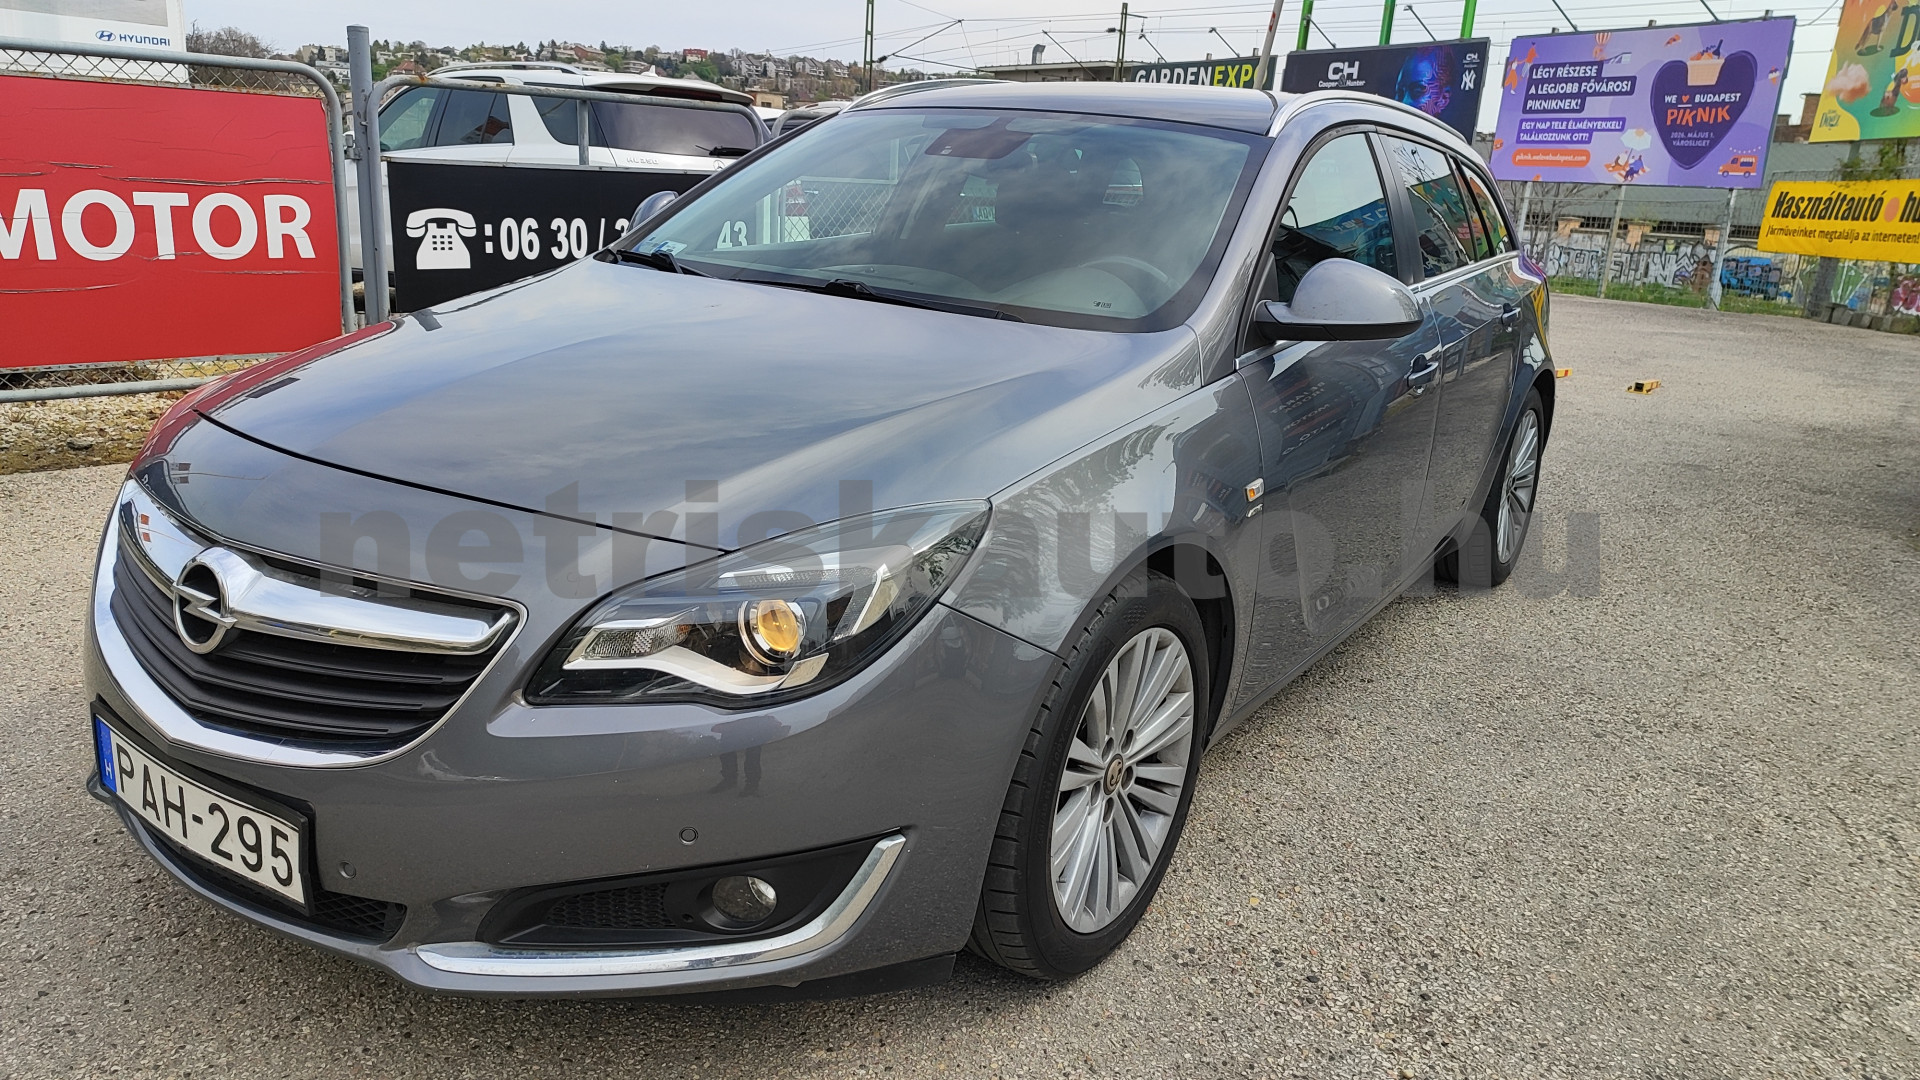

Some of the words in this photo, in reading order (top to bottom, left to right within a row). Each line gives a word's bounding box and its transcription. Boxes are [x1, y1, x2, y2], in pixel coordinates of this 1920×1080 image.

[119, 33, 171, 47] HYUNDAI
[1327, 60, 1360, 80] CH
[1532, 66, 1555, 79] LÉGY
[1557, 65, 1598, 77] RÉSZESE
[1529, 84, 1536, 94] A
[1538, 82, 1579, 94] LEGJOBB
[1580, 79, 1632, 93] FŐVÁROSI
[1526, 98, 1581, 110] PIKNIKNEK!
[1664, 95, 1678, 103] WE
[1694, 92, 1741, 103] BUDAPEST
[1666, 105, 1731, 127] PIKNIK
[1521, 121, 1534, 130] EGY
[1535, 121, 1551, 130] NAP
[1551, 121, 1568, 129] TELE
[1568, 120, 1622, 129] ÉLMÉNYEKKEL!
[1520, 132, 1571, 141] TALÁLKOZZUNK
[1672, 138, 1710, 147] VÁROSLIGET
[1771, 190, 1887, 222] Használtautó
[0, 188, 316, 261] MOTOR
[550, 217, 588, 260] 30
[1818, 228, 1860, 243] megtalálja
[1861, 232, 1870, 242] az
[1871, 230, 1920, 244] interneten!
[115, 742, 293, 887] PAH-295
